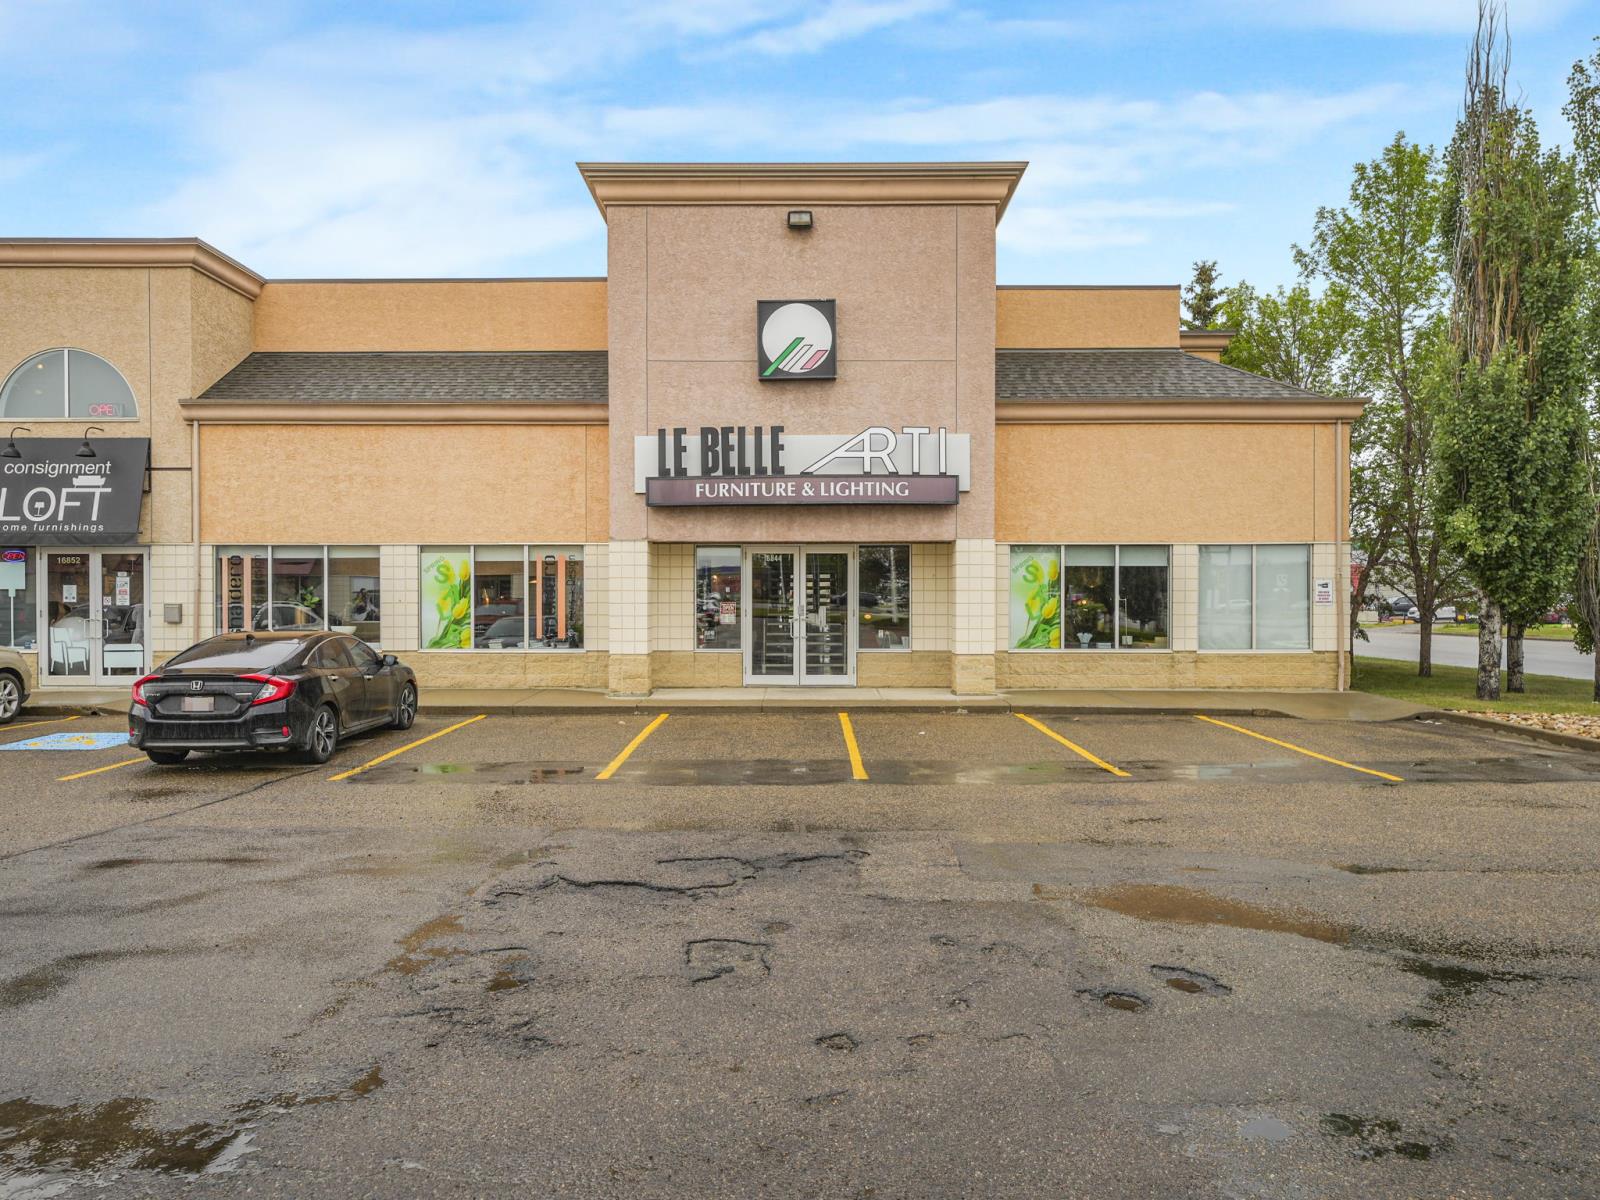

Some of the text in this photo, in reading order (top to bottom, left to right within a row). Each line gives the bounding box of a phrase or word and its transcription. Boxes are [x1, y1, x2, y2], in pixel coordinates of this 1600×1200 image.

[88, 404, 124, 416] OPEN
[658, 426, 947, 476] LE BELLE ARTI
[4, 460, 112, 478] consignment
[695, 481, 909, 498] FURNITURE & LIGHTING
[0, 487, 112, 521] LOFT
[0, 523, 104, 533] ome furnishings
[56, 556, 81, 564] 16852
